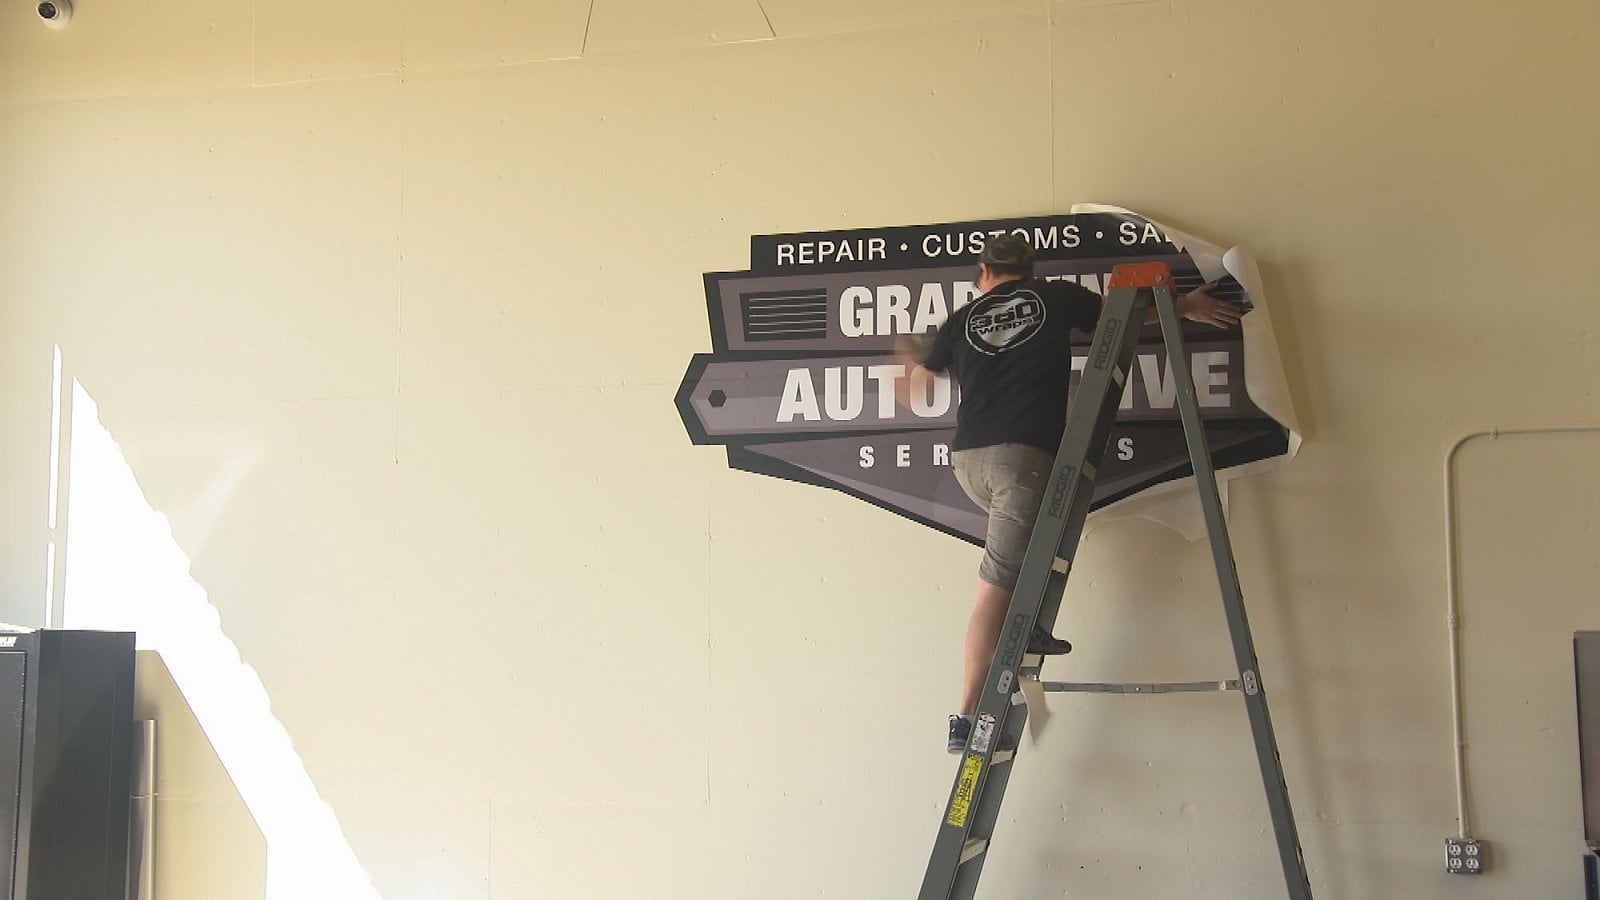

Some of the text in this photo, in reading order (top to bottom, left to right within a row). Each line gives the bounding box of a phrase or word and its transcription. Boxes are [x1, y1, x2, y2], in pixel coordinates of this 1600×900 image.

[776, 238, 887, 266] REPAIR
[1093, 318, 1118, 369] RIDGID
[1047, 464, 1072, 518] RIDGID
